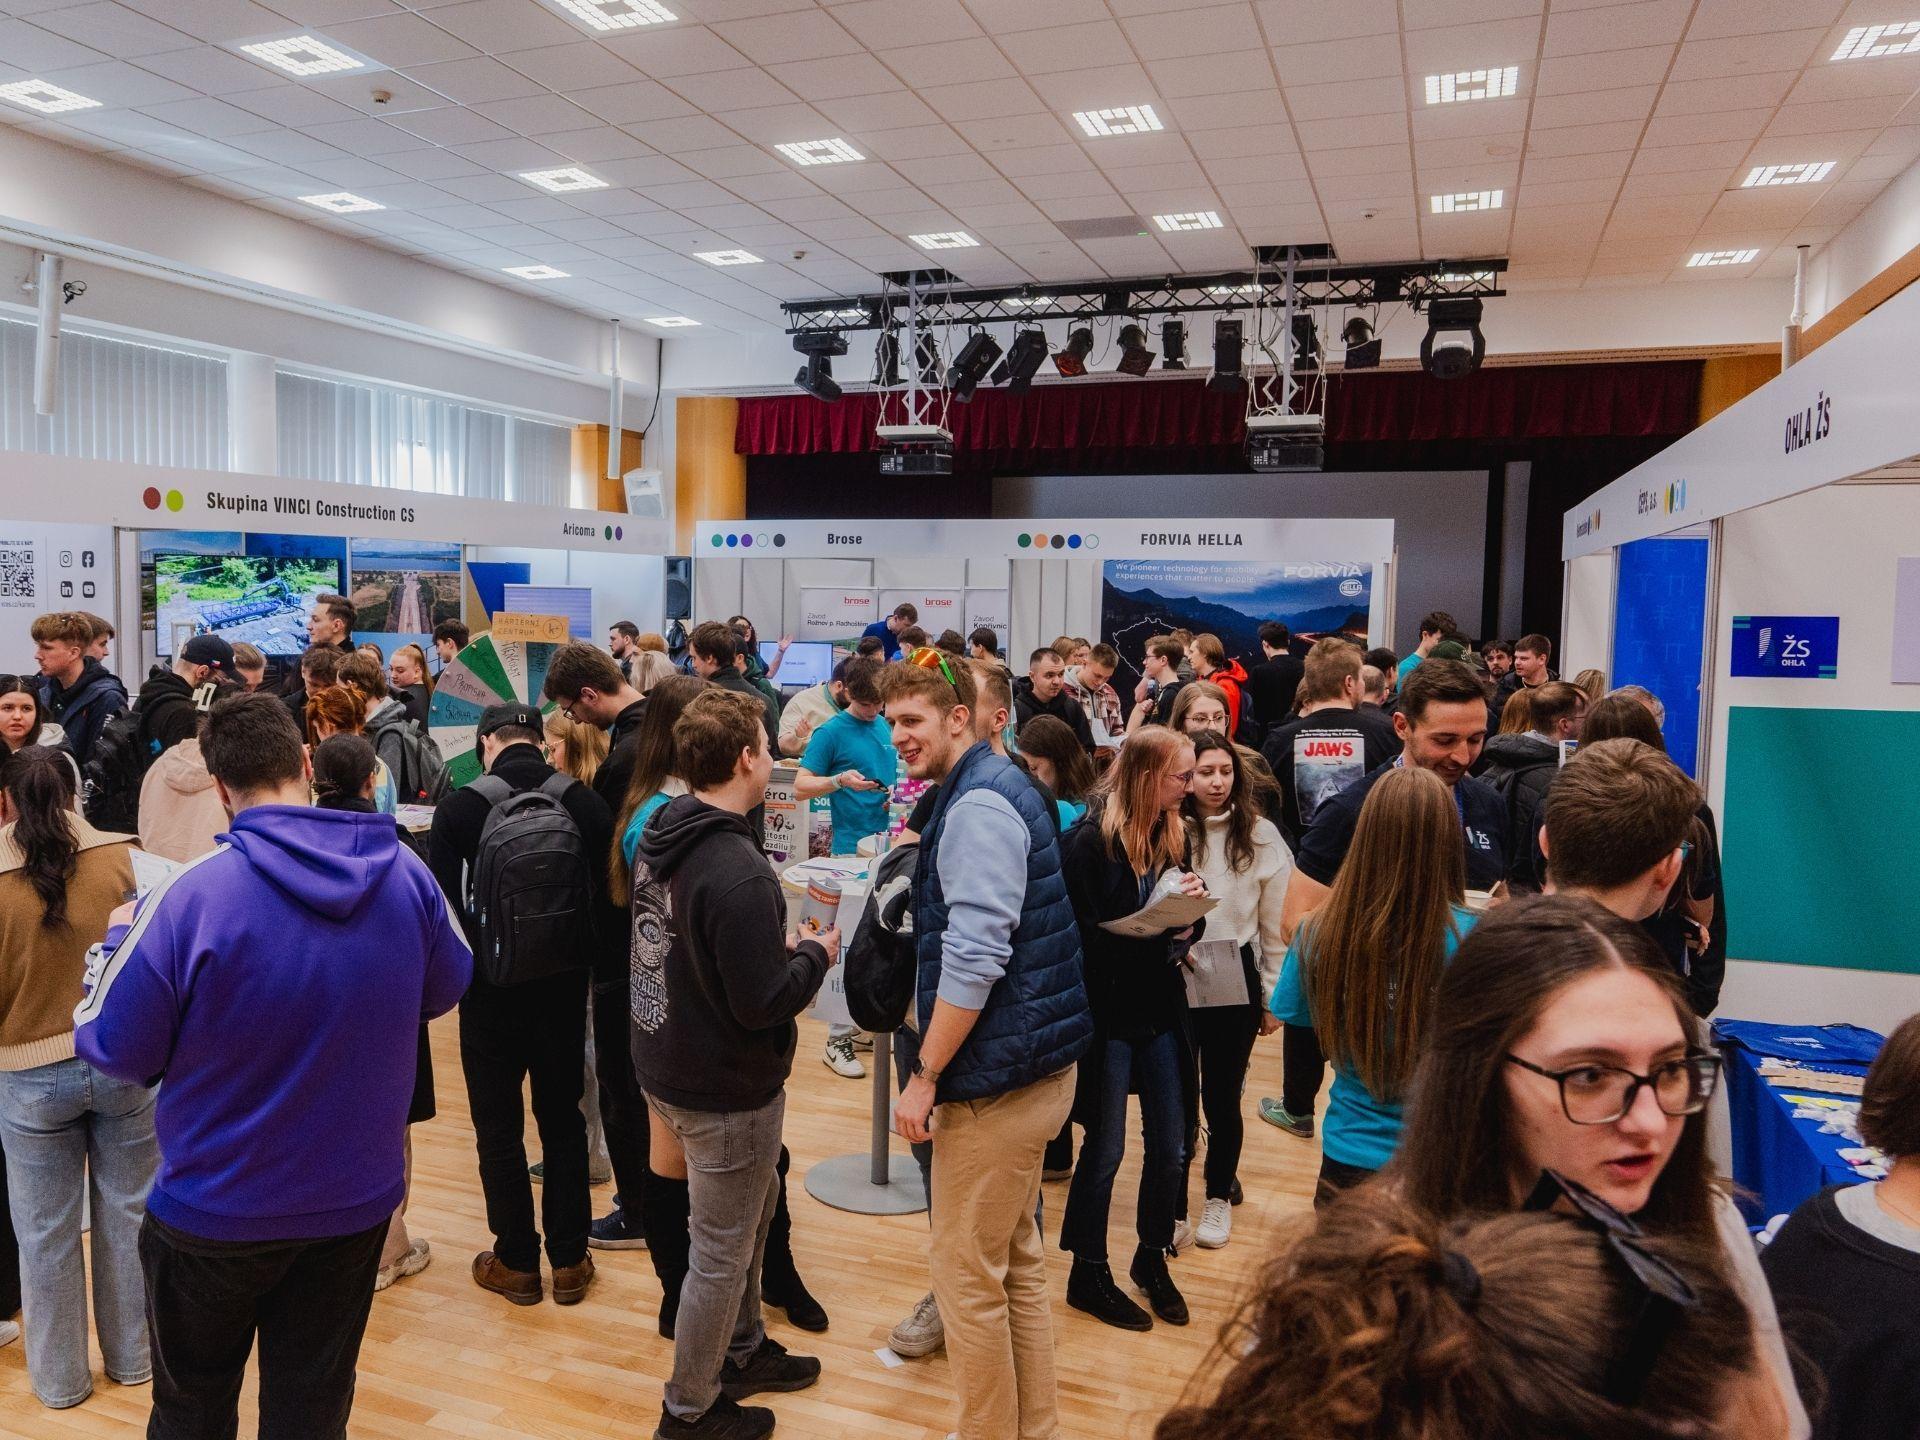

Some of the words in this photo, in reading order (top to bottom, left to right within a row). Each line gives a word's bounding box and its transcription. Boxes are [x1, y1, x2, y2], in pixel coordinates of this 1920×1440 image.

[1785, 407, 1811, 455] OHLA
[1815, 390, 1831, 441] ŽS
[206, 491, 268, 514] Skupina
[273, 496, 310, 515] VINCI
[316, 500, 396, 521] Construction
[400, 507, 415, 522] CS
[563, 522, 595, 537] Aricoma
[827, 533, 863, 545] Brose
[1140, 533, 1192, 546] FORVIA
[1197, 533, 1243, 546] HELLA
[1130, 564, 1160, 572] pioneer
[1163, 565, 1208, 574] technology
[1210, 565, 1223, 573] for
[1225, 566, 1258, 575] mobility
[1283, 565, 1363, 579] FORVIA
[1115, 573, 1163, 581] experiences
[1214, 575, 1224, 583] to
[844, 596, 870, 605] brose
[925, 597, 953, 606] brose
[973, 622, 1007, 630] Kopřivnic
[1781, 634, 1811, 658] ŽS
[1781, 659, 1806, 667] OHLA
[1304, 742, 1354, 757] JAWS
[764, 832, 789, 841] itosti
[1475, 830, 1490, 845] ŽS
[765, 842, 788, 851] ozdílu
